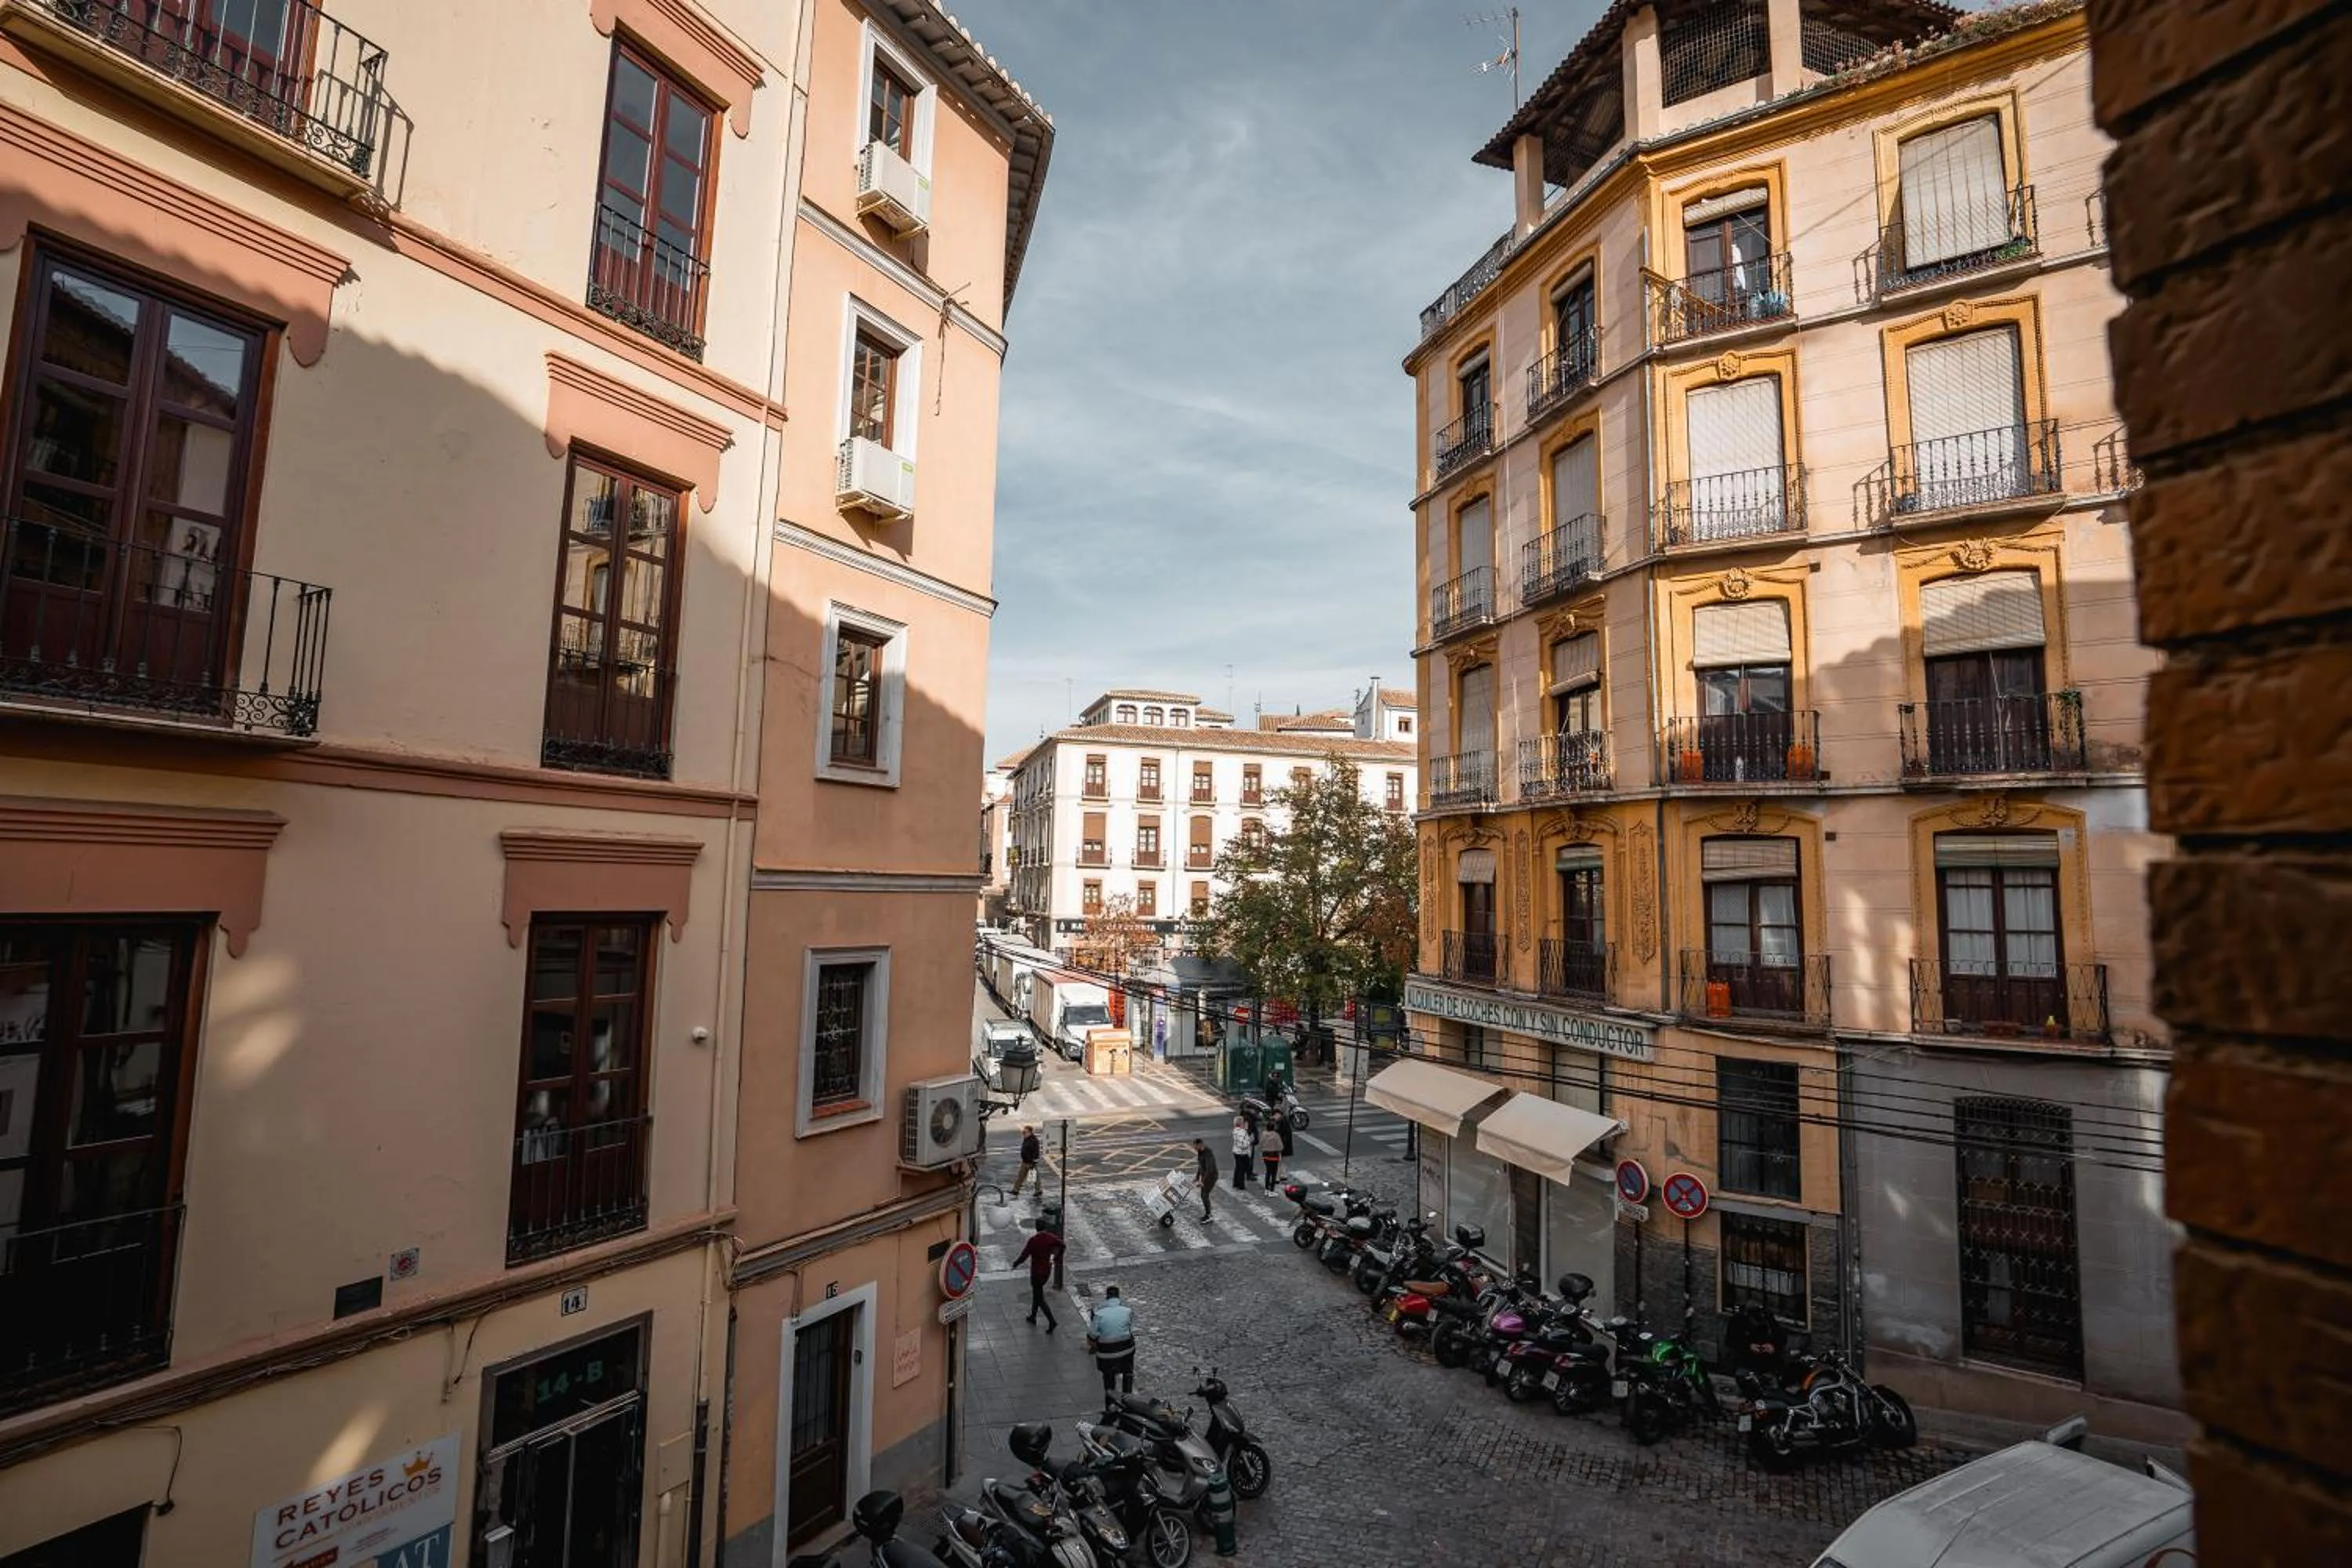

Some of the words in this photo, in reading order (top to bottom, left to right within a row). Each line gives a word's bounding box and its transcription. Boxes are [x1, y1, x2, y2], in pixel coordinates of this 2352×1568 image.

[1408, 988, 1444, 1013] ALQUILER
[1446, 996, 1458, 1017] DE
[1461, 999, 1501, 1024] COCHES
[1503, 1007, 1526, 1030] CON
[1527, 1011, 1537, 1033] Y
[1541, 1013, 1558, 1038] SIN
[1563, 1018, 1644, 1056] CONDUCTOR
[564, 1295, 581, 1313] 14
[536, 1360, 603, 1403] 14-B
[277, 1468, 384, 1526] REYES
